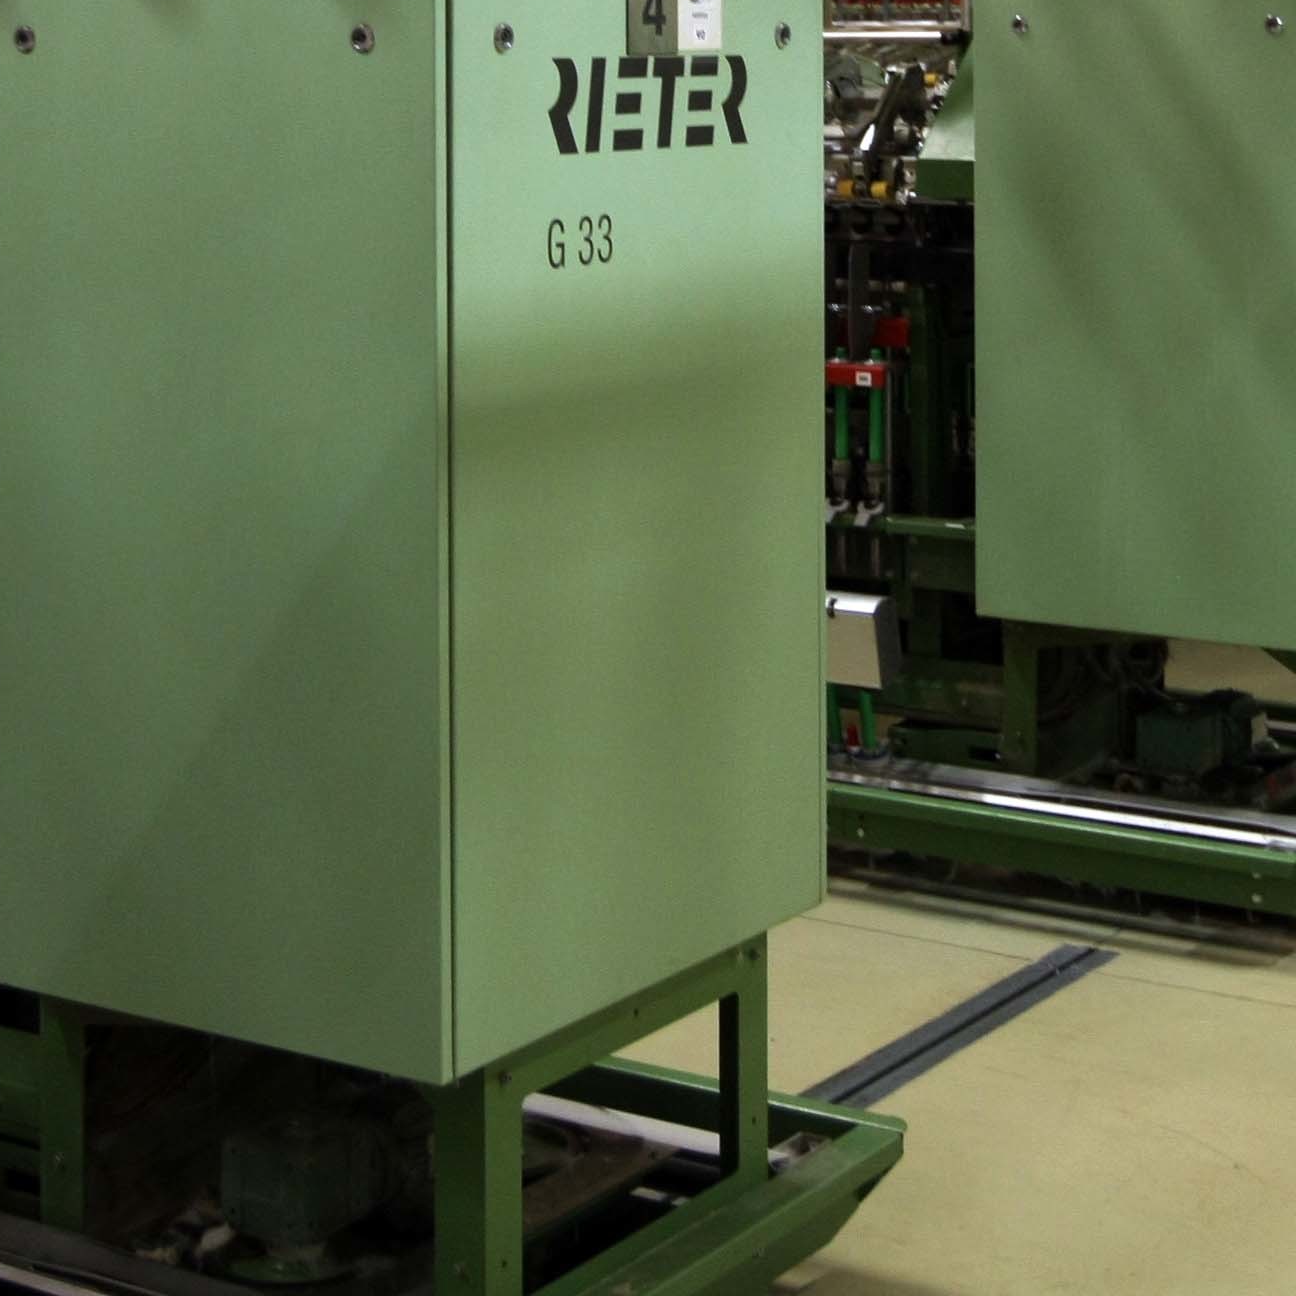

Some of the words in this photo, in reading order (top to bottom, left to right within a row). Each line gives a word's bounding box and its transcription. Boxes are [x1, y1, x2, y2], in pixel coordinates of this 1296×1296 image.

[548, 54, 748, 155] RIETER
[547, 219, 566, 269] G
[578, 214, 613, 266] 33
